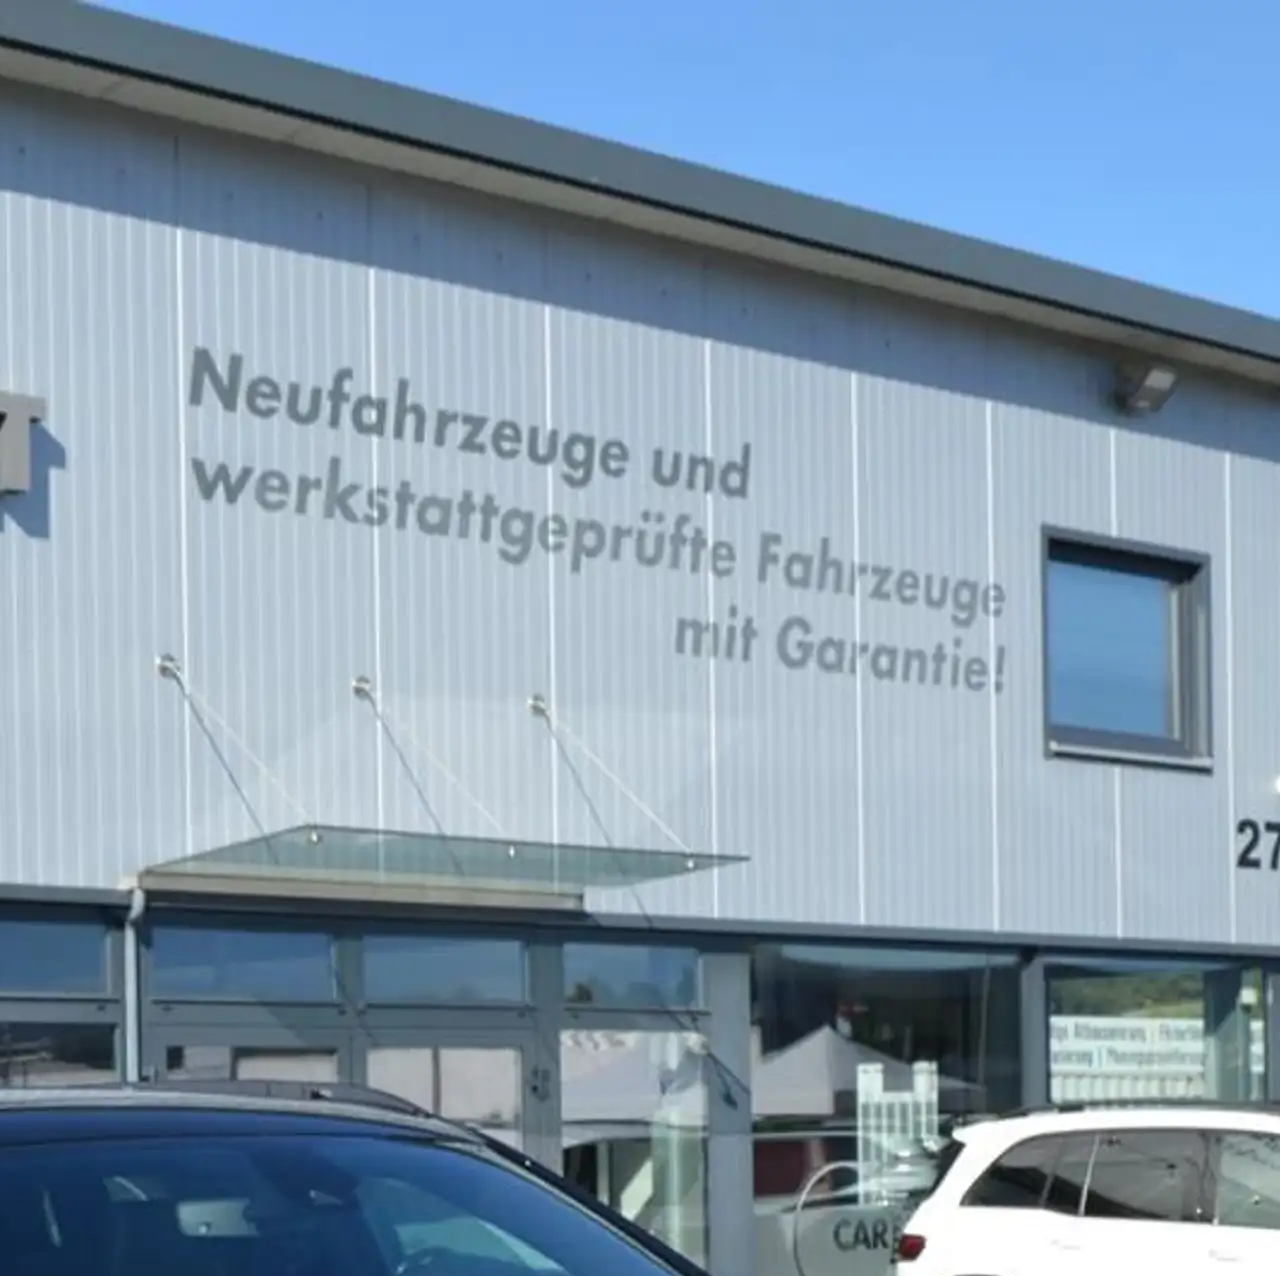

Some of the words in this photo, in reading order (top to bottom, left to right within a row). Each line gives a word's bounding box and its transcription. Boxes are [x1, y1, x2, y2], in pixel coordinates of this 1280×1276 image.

[189, 346, 629, 488] Neufahrzeuge
[652, 444, 751, 499] und
[191, 456, 735, 577] werkstattgeprüfte
[757, 533, 1006, 627] Fahrzeuge
[675, 605, 756, 662] mit
[776, 615, 1007, 694] Garantie!
[833, 1217, 888, 1252] CAR
